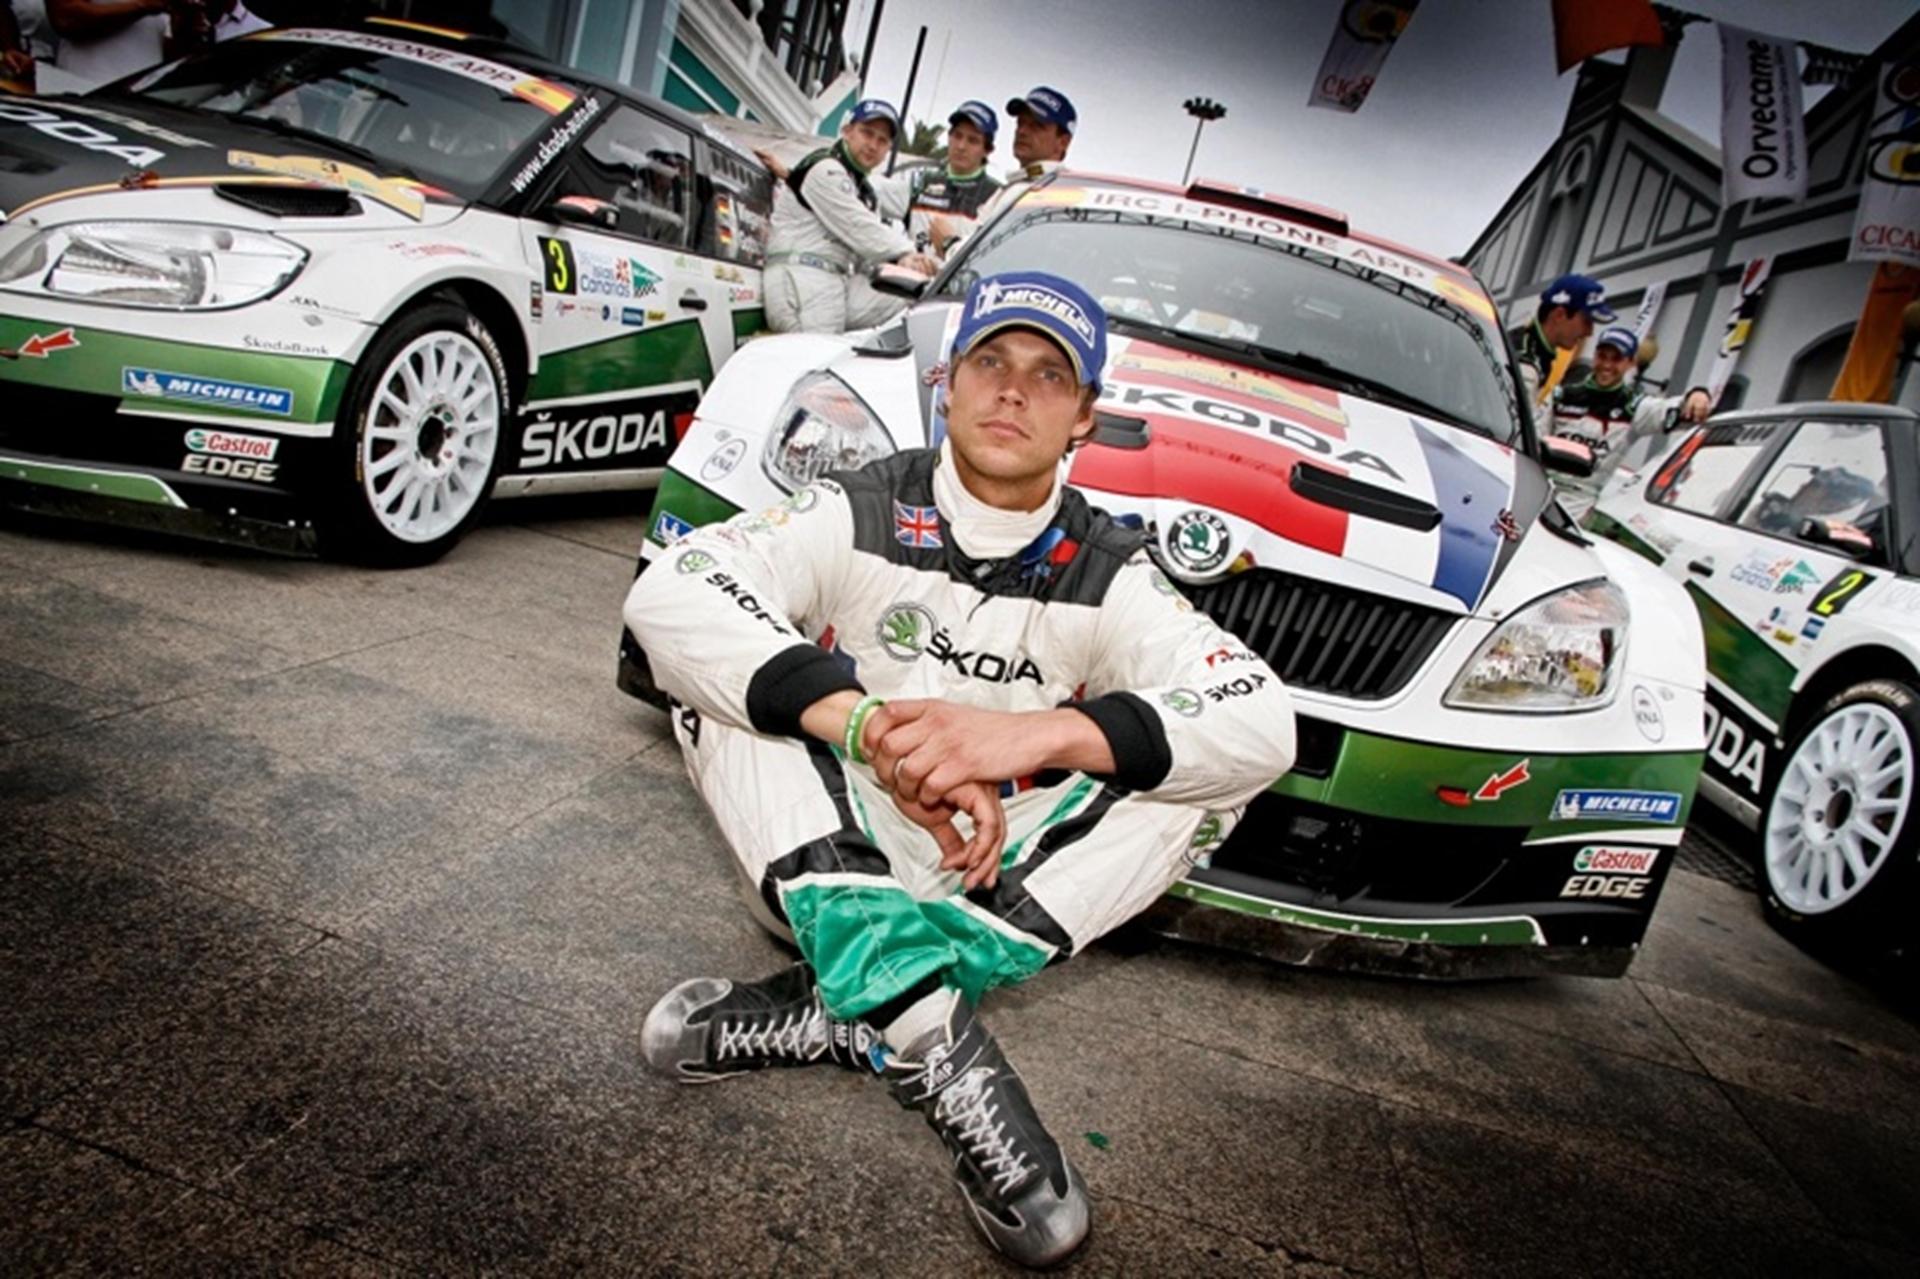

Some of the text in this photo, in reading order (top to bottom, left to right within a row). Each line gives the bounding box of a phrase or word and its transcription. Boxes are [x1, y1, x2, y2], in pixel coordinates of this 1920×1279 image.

[450, 60, 517, 82] APP
[1741, 39, 1779, 179] Orvecame
[1094, 192, 1425, 280] IRC I-PHONE APP
[1859, 224, 1920, 251] CICA
[548, 239, 569, 292] 3
[1002, 289, 1091, 337] MICHELIN
[167, 378, 285, 406] MICHELIN
[208, 433, 272, 458] Castrol
[518, 411, 667, 469] ŠKODA
[180, 453, 280, 483] EDGE
[1815, 569, 1866, 616] 2
[1583, 796, 1675, 814] MICHELIN
[1591, 849, 1651, 871] Castrol
[1559, 875, 1652, 899] EDGE
